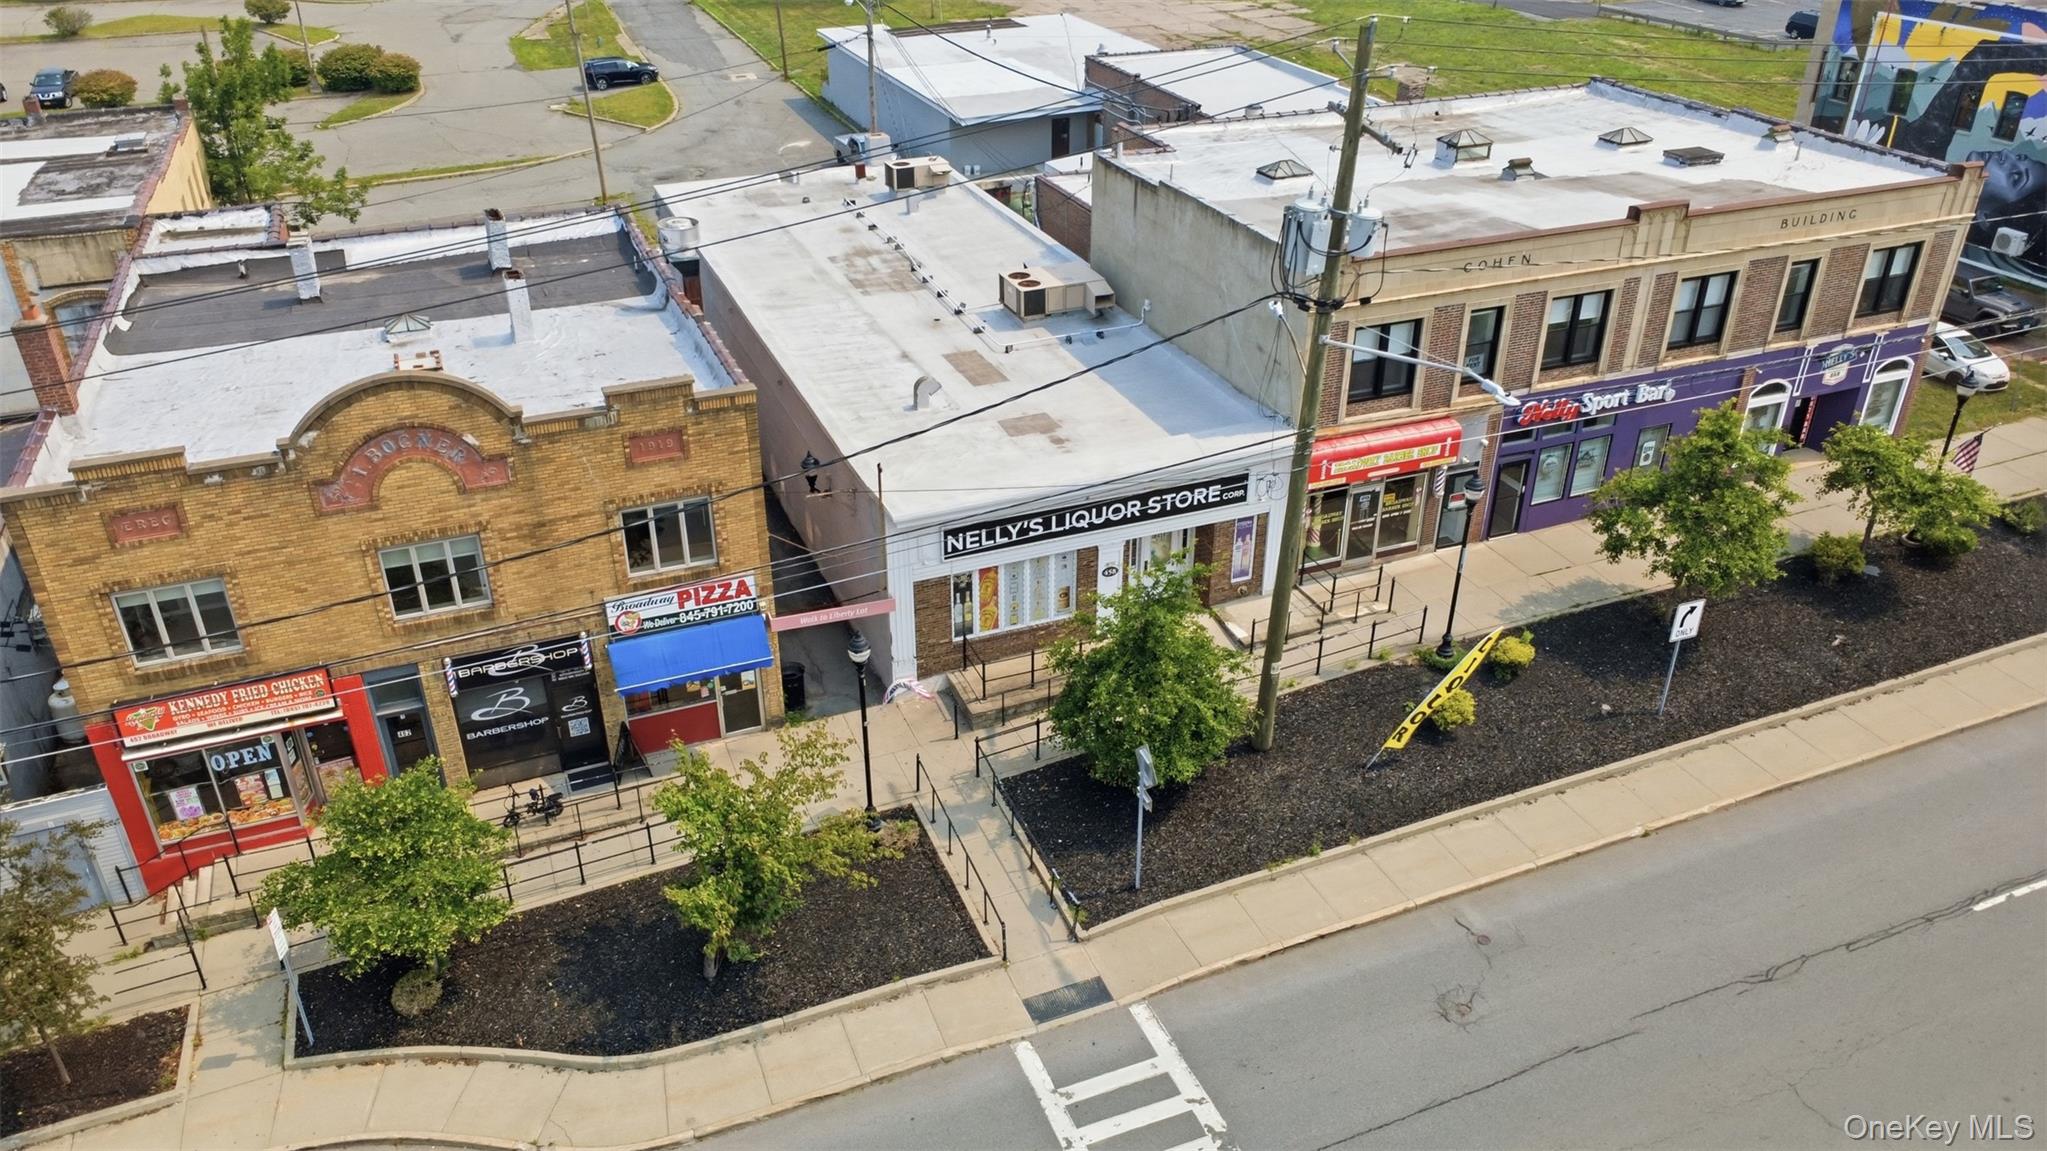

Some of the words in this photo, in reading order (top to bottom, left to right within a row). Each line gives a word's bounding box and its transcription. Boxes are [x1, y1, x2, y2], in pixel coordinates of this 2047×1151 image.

[1780, 209, 1858, 229] BUILDING
[1581, 388, 1630, 415] Sport
[640, 438, 674, 451] 1919
[947, 517, 1044, 553] NELLY'S
[1051, 500, 1141, 533] LIQUOR
[1147, 484, 1222, 514] STORE
[611, 594, 677, 614] Broadway
[676, 579, 753, 610] PIZZA
[679, 600, 754, 624] 845-791-7200
[800, 615, 818, 624] Walk
[819, 614, 828, 622] to
[829, 609, 855, 621] Liberty
[856, 607, 869, 616] Lot
[1675, 627, 1694, 637] ONLY
[458, 647, 578, 678] BARBERSHOP
[168, 689, 228, 716] KENNEDY
[231, 683, 269, 705] FRIED
[271, 673, 325, 696] CHICKEN
[466, 716, 549, 740] BARBERSHOP
[210, 742, 273, 772] OPEN
